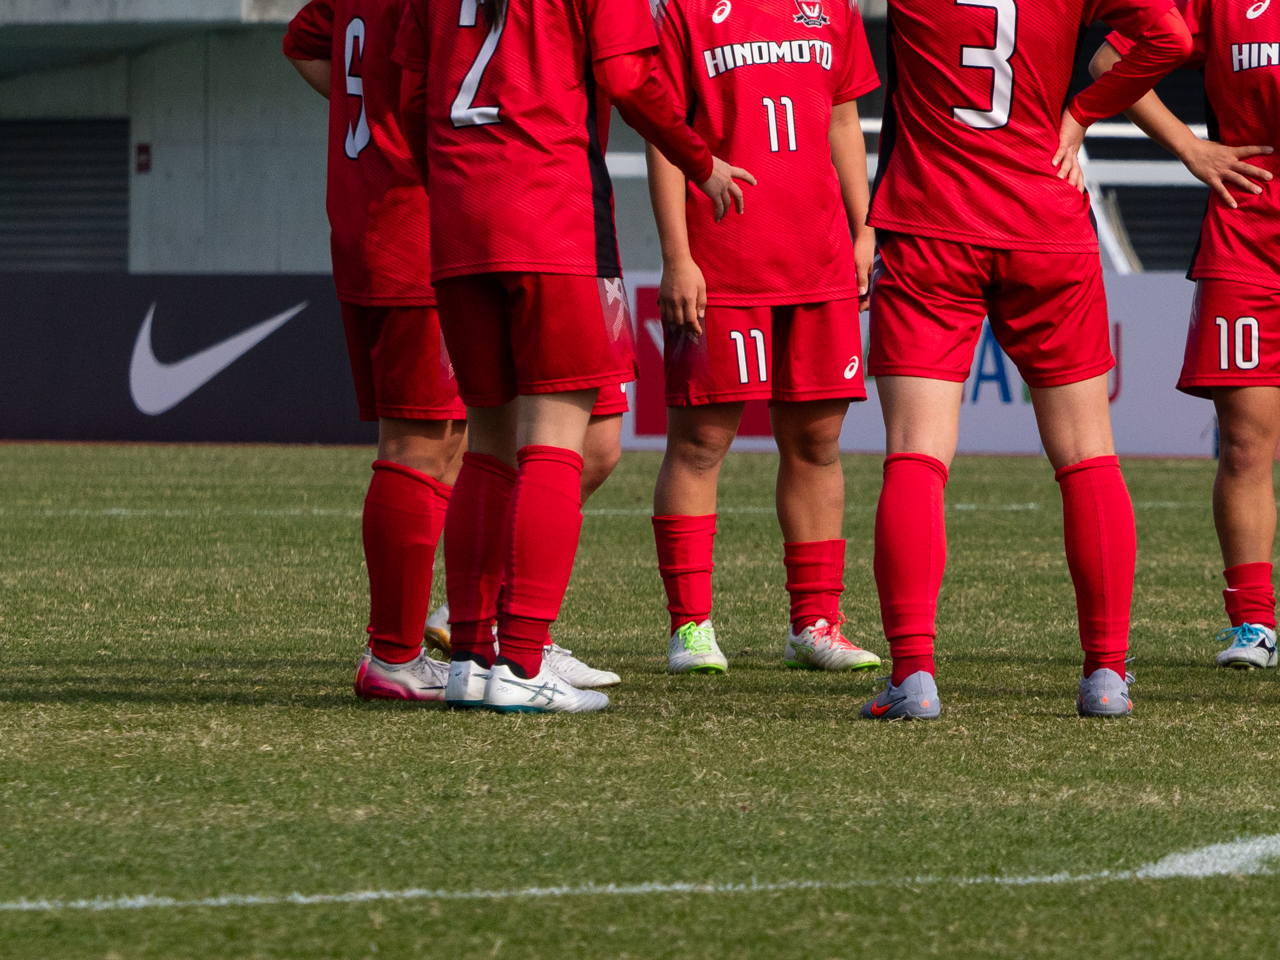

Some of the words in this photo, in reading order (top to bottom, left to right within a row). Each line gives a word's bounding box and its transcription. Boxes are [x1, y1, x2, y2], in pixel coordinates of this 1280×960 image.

[703, 39, 833, 78] HINOMOTO
[762, 96, 797, 152] 11
[730, 329, 767, 384] 11
[1215, 316, 1259, 370] 10
